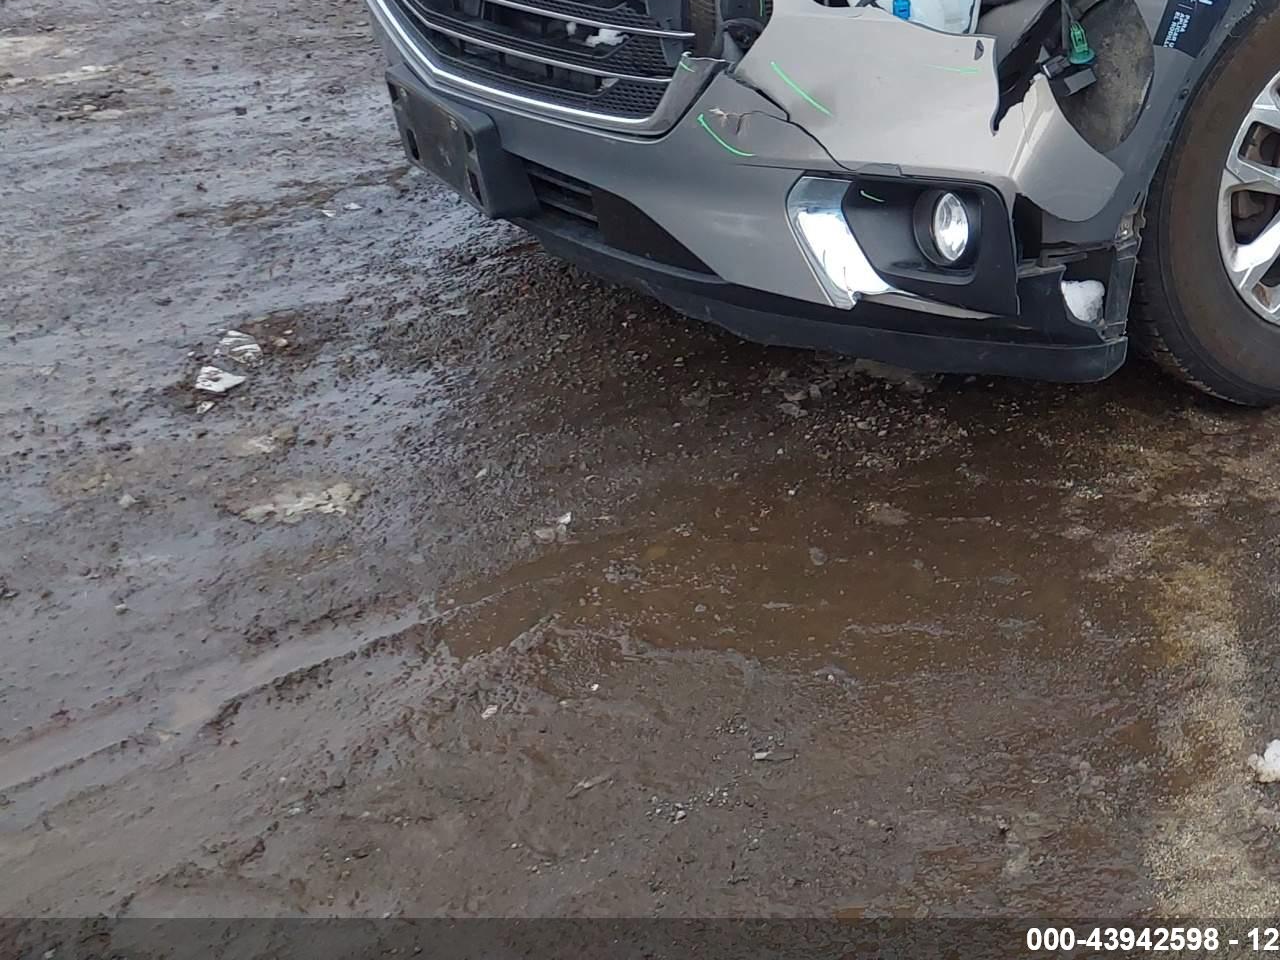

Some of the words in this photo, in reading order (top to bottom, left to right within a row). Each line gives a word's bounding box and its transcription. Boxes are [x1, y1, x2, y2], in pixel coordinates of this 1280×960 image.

[1173, 11, 1181, 21] EL
[1180, 14, 1191, 33] PARA
[1171, 12, 1185, 41] APLICAR
